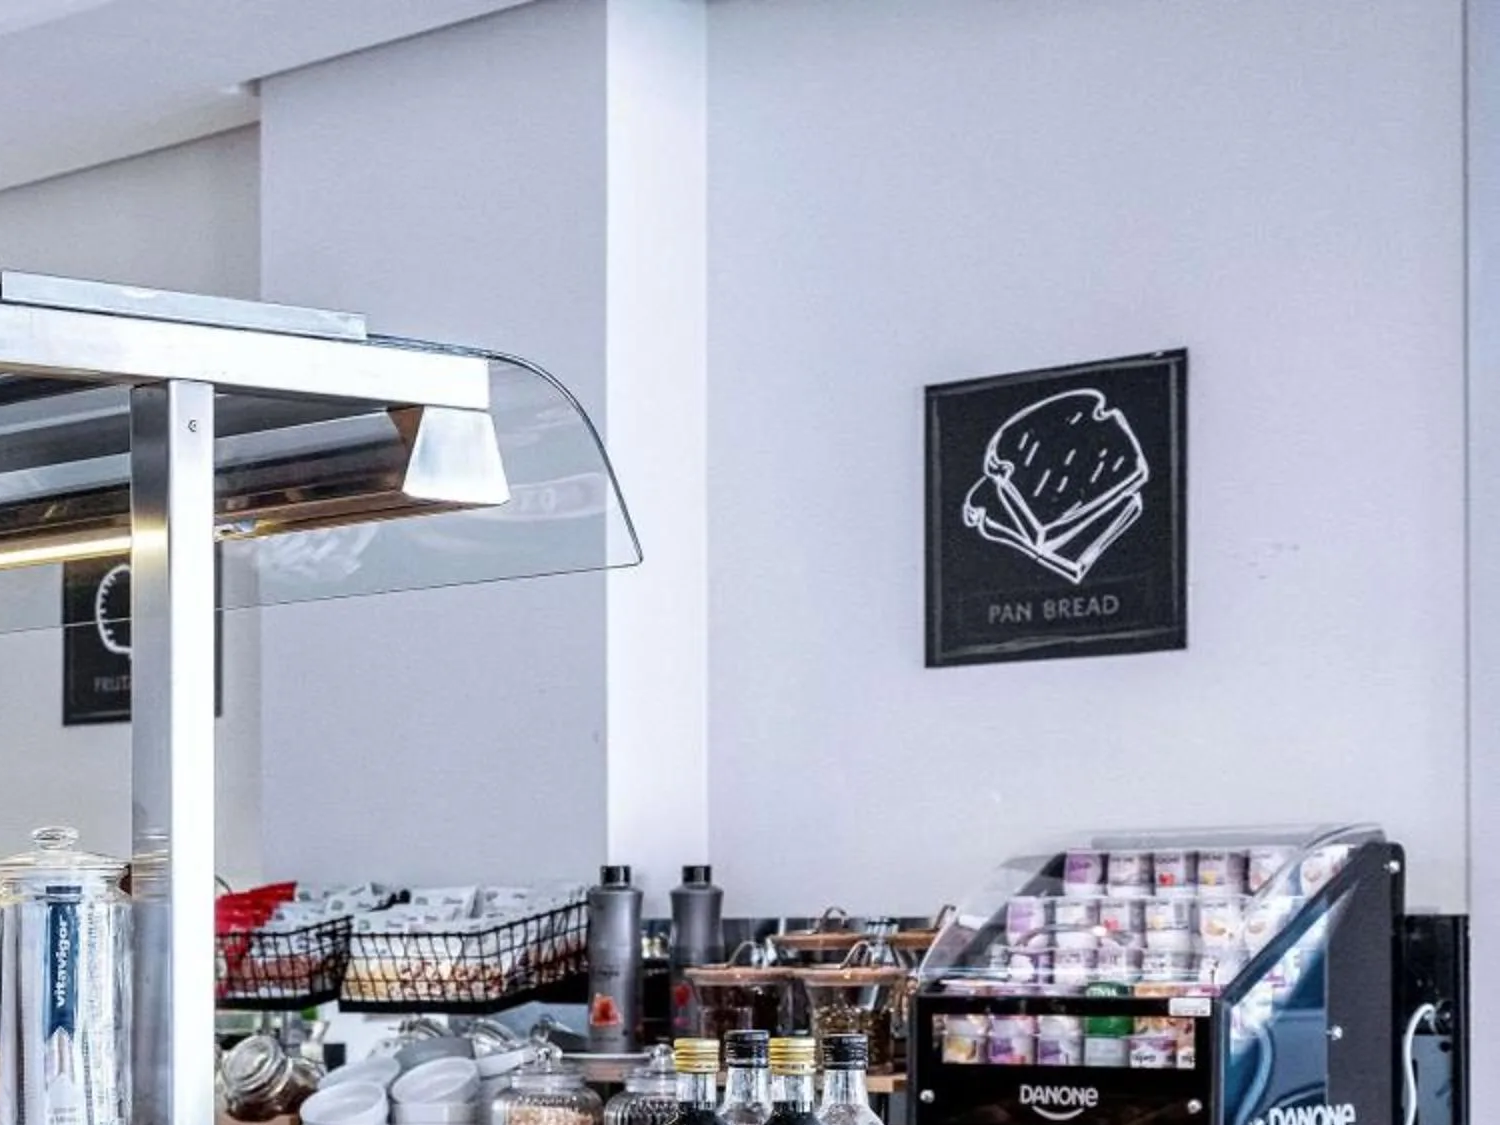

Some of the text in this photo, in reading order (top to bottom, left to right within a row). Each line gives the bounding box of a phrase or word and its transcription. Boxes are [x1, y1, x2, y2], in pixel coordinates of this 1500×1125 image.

[988, 594, 1120, 624] PAN BREAD
[54, 913, 71, 1008] vitavigor
